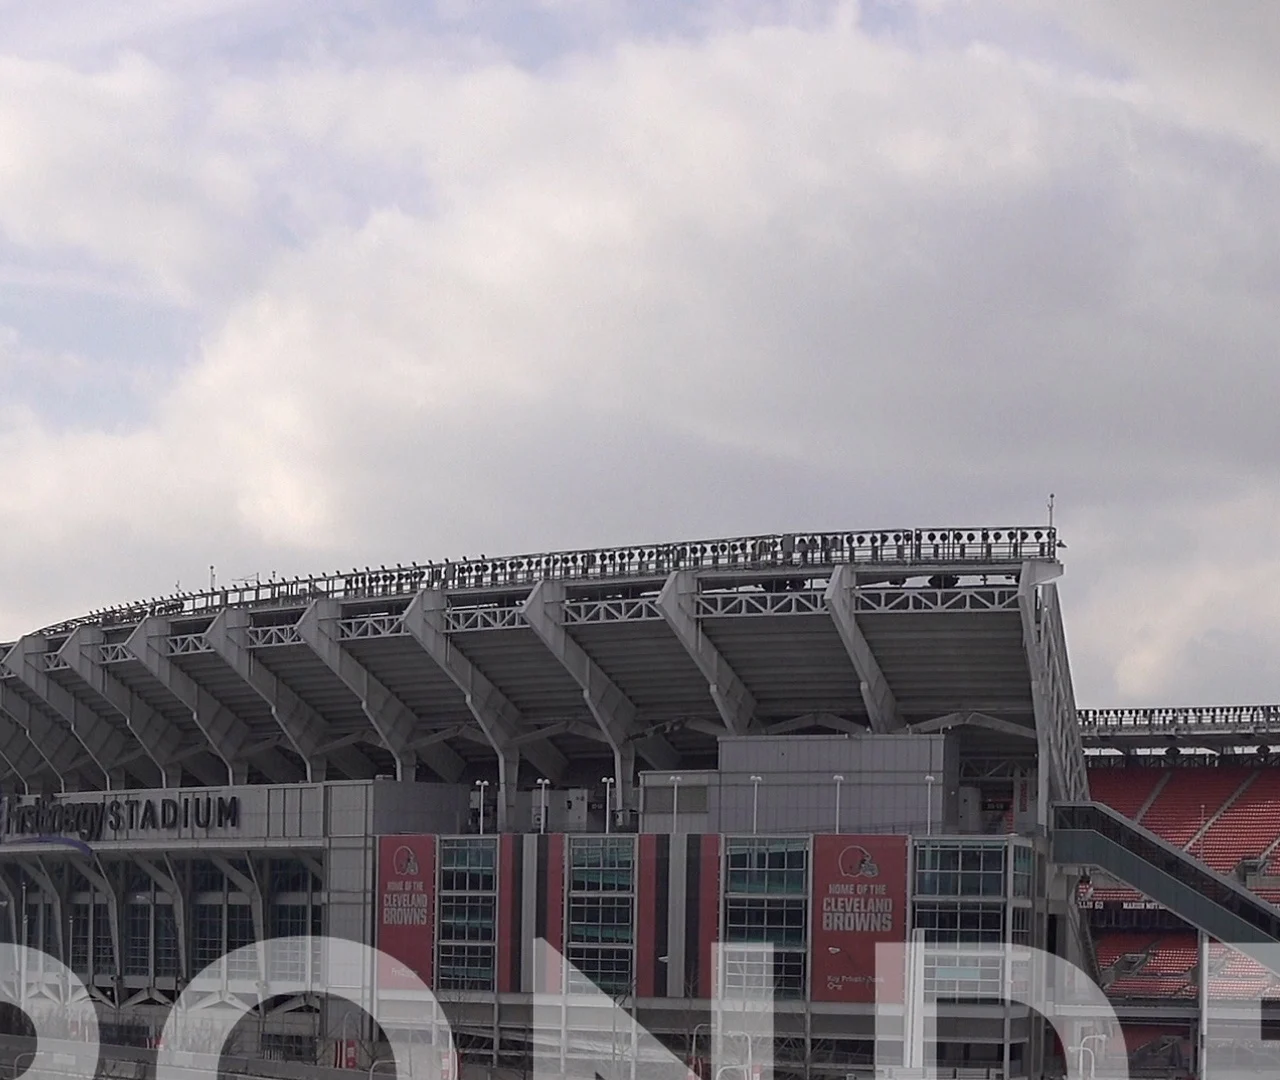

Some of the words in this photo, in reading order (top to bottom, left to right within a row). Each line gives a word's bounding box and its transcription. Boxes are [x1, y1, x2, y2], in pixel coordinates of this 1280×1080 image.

[108, 796, 240, 831] STADIUM
[829, 884, 854, 894] HOME
[856, 884, 868, 894] OF
[869, 884, 886, 895] THE
[383, 893, 428, 907] CLEVELAND
[823, 898, 893, 913] CLEVELAND
[383, 907, 427, 926] BROWNS
[823, 913, 893, 932] BROWNS
